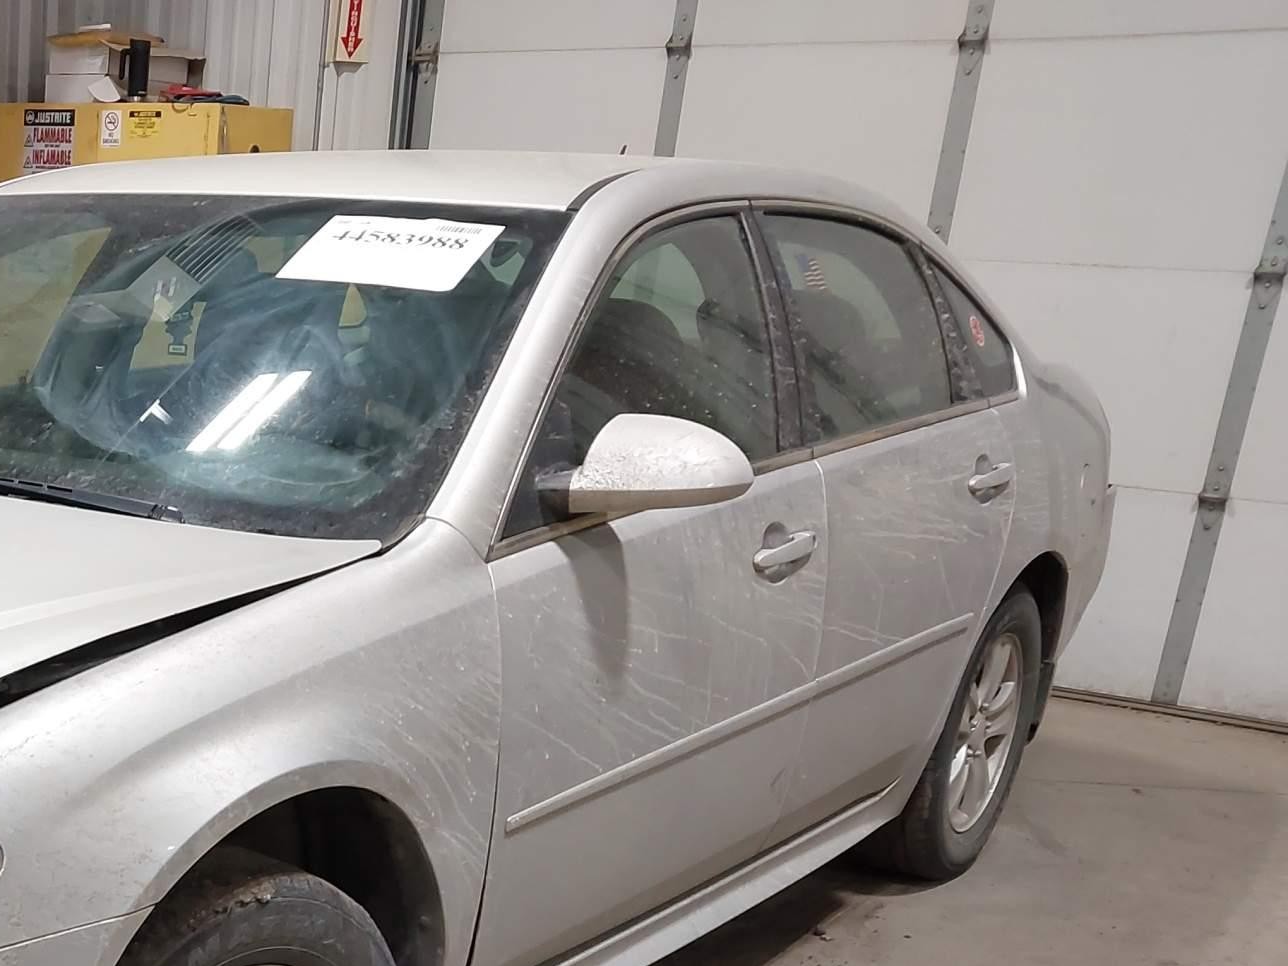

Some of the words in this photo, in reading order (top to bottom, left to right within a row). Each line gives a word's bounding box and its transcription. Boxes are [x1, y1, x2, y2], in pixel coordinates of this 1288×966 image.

[34, 111, 71, 123] JUSTRITE
[33, 127, 73, 144] FLAMMABLE
[32, 149, 72, 166] INFLAMABLE
[332, 230, 469, 249] 44583988
